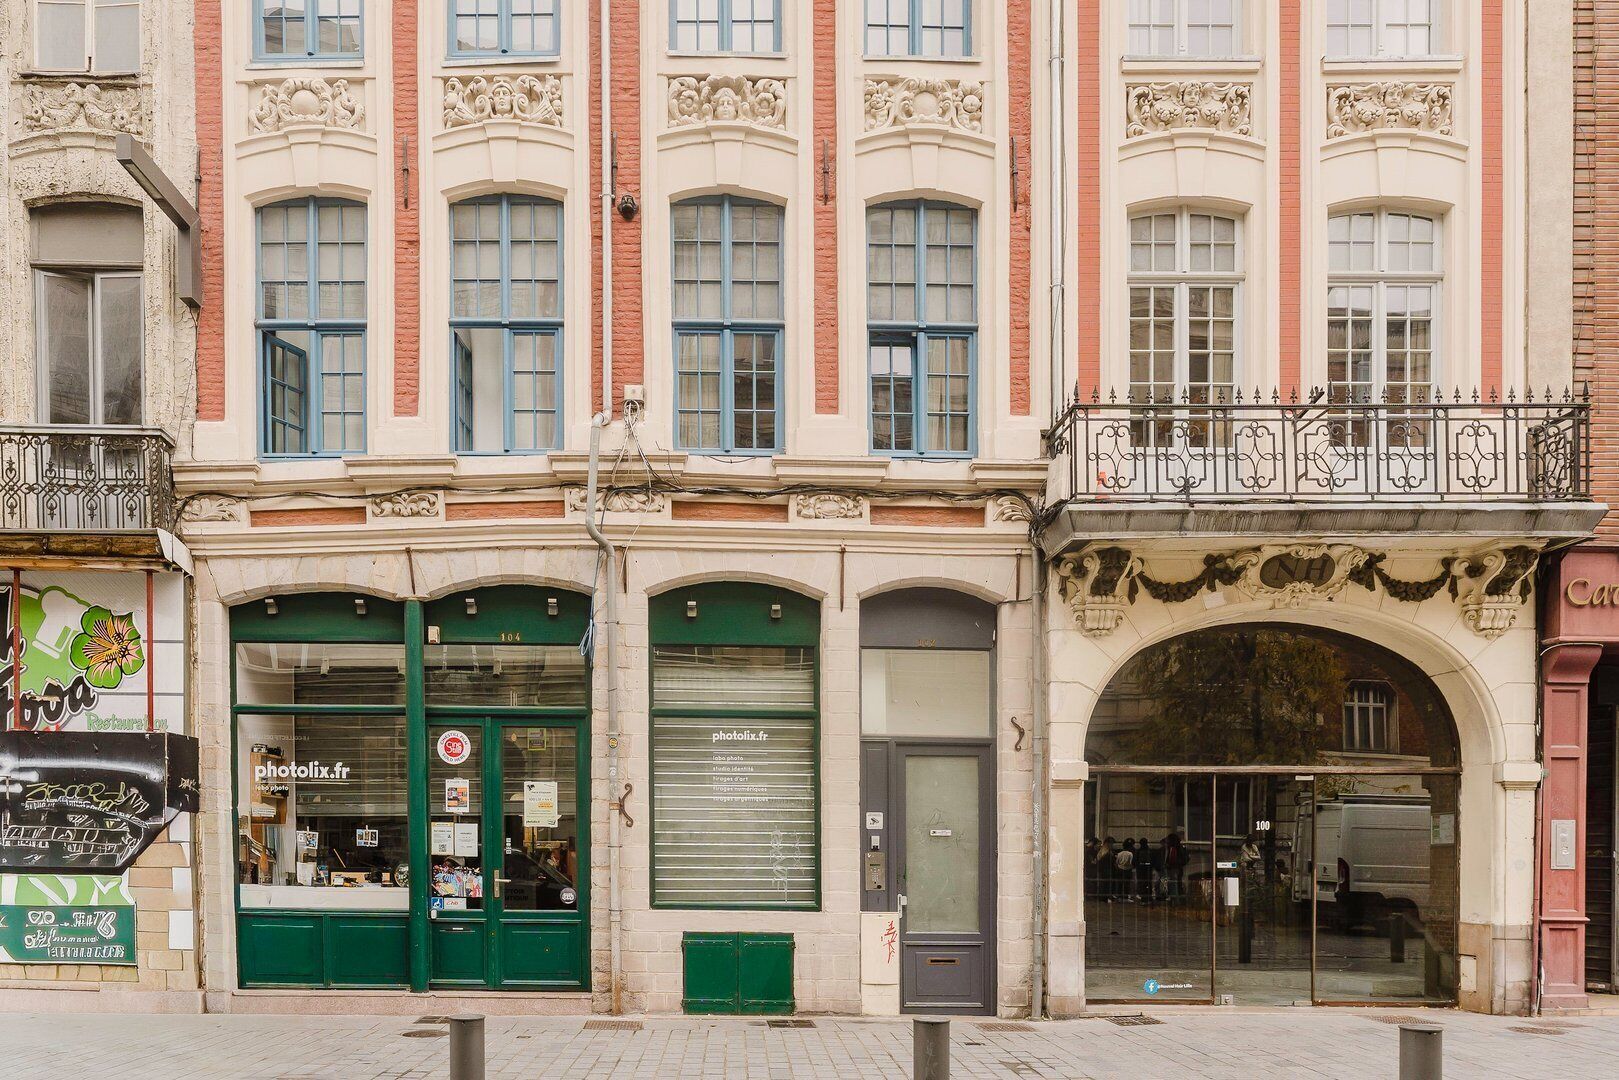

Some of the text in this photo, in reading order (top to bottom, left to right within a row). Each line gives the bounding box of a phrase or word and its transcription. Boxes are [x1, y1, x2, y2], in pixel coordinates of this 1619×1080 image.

[1275, 557, 1329, 580] NH
[500, 632, 520, 641] 104
[85, 712, 168, 731] Restauraton
[713, 730, 768, 743] photolix.fr
[255, 760, 350, 782] photolix.fr
[1256, 820, 1270, 831] 100
